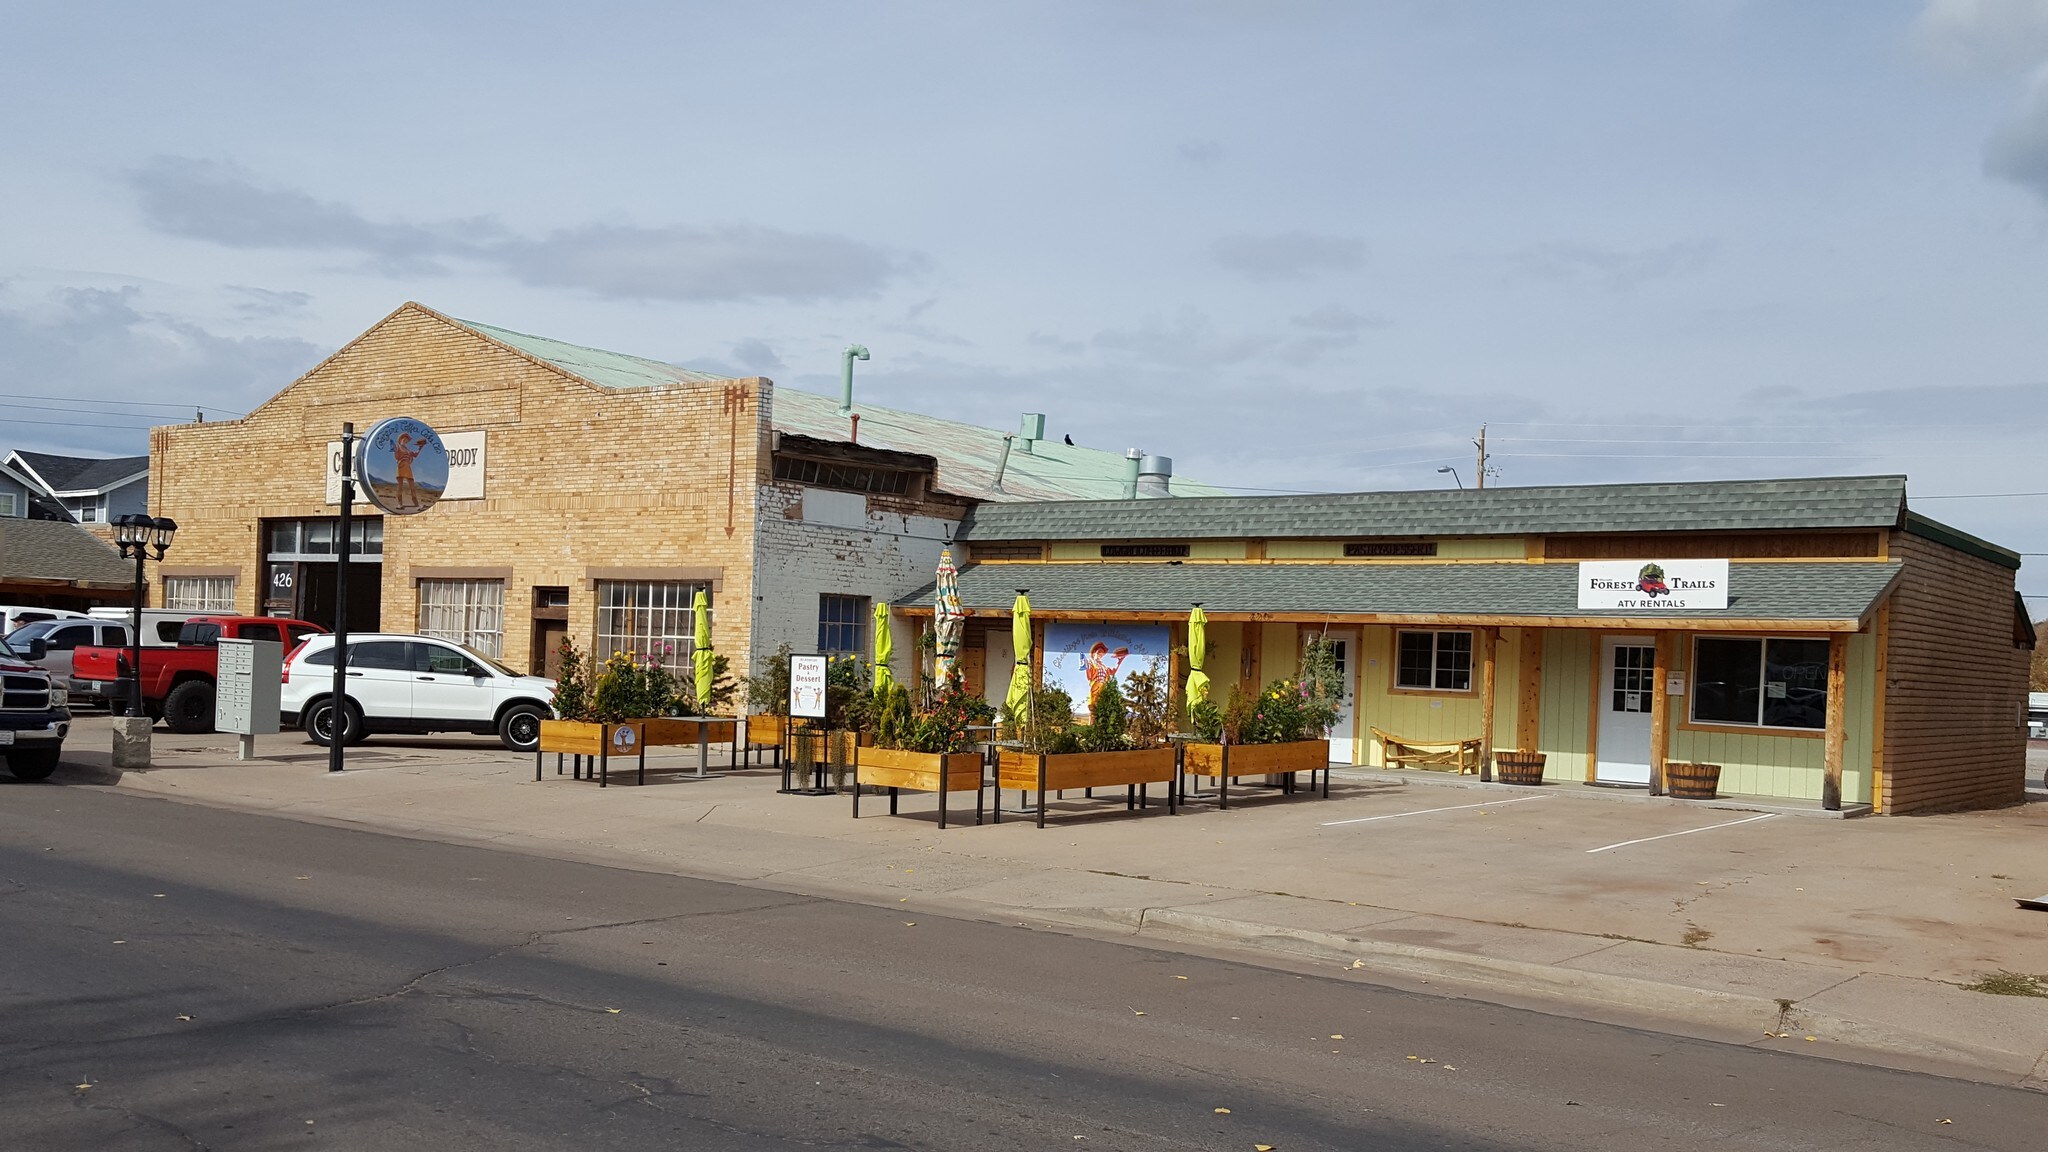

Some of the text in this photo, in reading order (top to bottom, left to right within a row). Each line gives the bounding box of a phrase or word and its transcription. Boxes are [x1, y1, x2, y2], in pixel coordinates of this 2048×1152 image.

[273, 573, 293, 587] 426
[1590, 577, 1715, 589] FOREST TRAILS
[1617, 600, 1685, 608] ATV RENTALS
[798, 663, 819, 672] Pastry
[1782, 665, 1827, 680] OPEN
